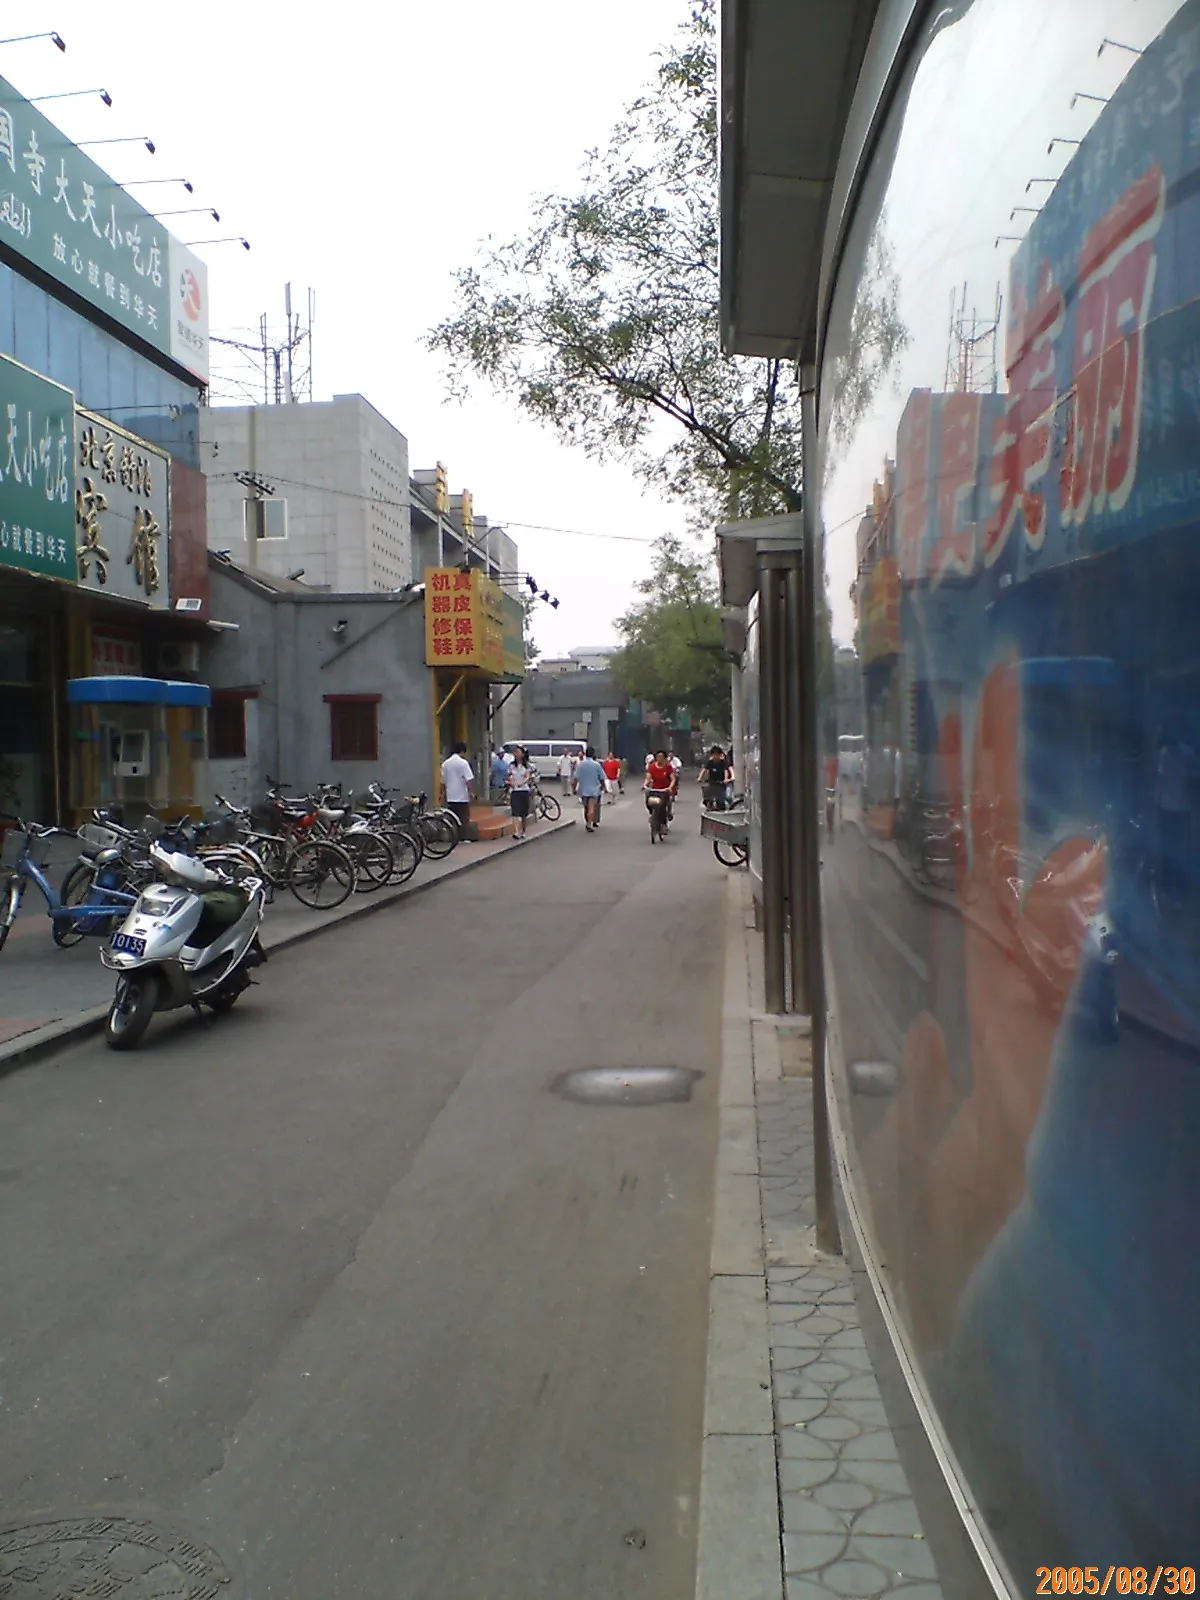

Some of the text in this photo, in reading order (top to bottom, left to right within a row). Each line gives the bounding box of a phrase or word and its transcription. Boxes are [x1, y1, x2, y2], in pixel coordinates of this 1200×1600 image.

[432, 573, 453, 656] 机器修鞋
[453, 572, 474, 656] 真皮保养
